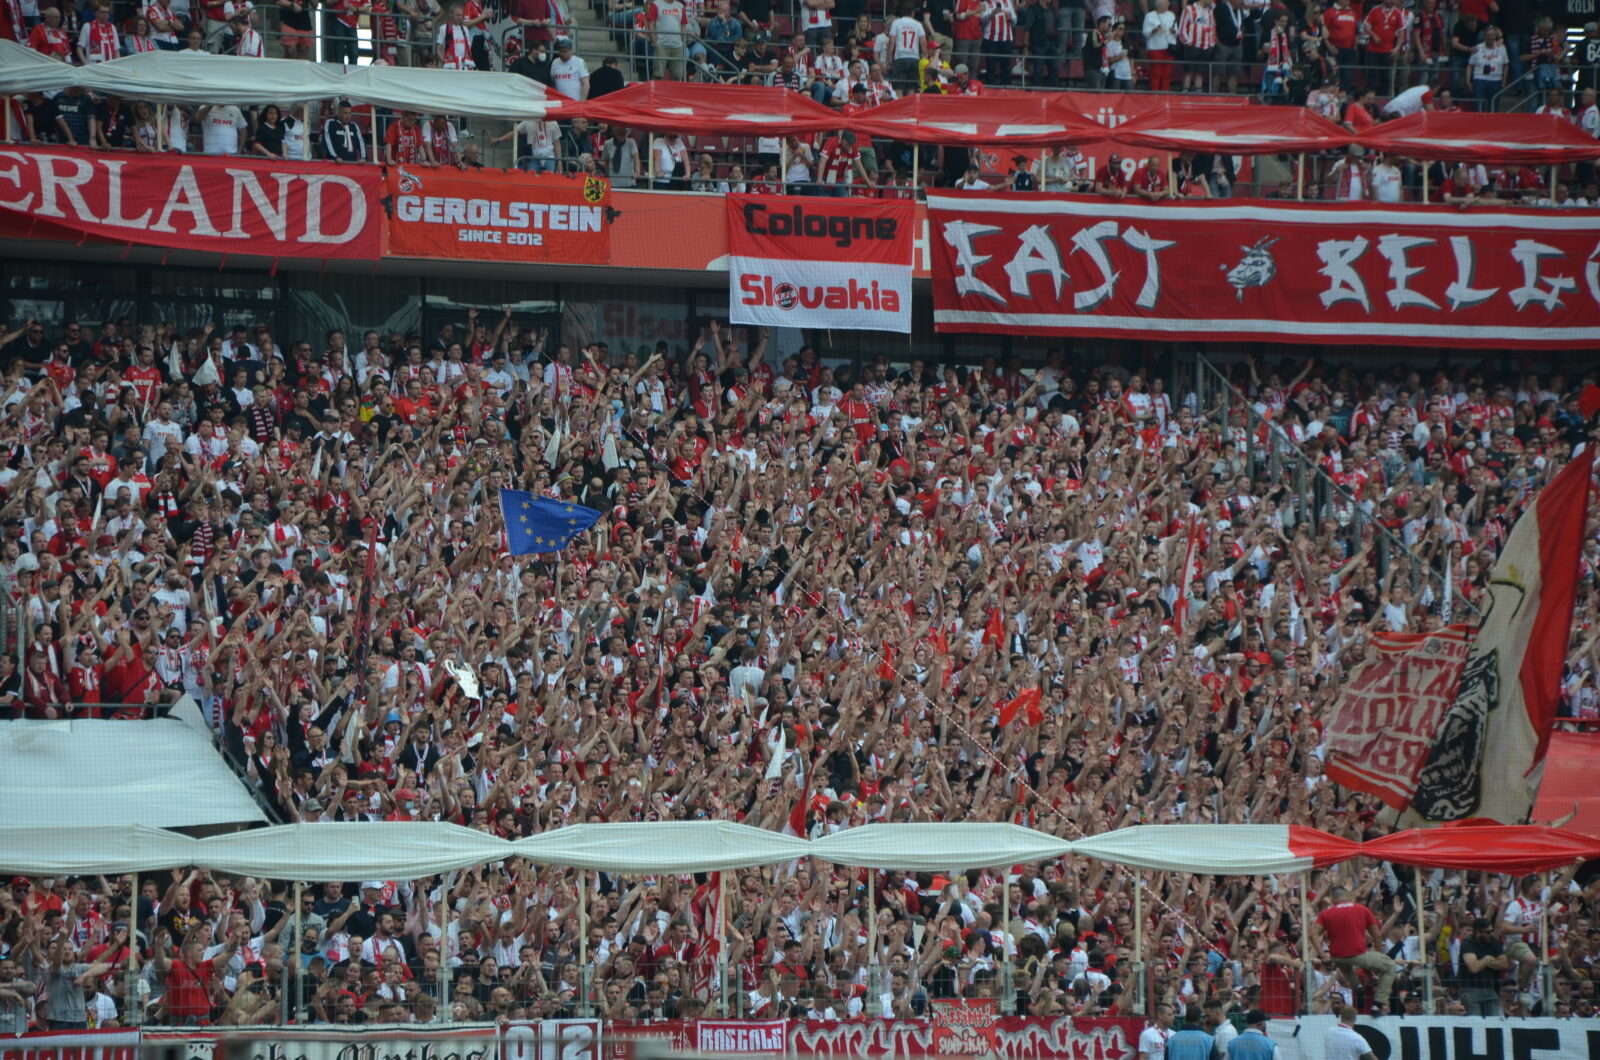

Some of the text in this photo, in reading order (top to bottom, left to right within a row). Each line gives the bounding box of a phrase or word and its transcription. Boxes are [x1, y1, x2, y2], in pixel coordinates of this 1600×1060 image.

[902, 30, 916, 48] 17
[212, 117, 233, 126] REWE
[397, 195, 602, 232] GEROLSTEIN
[743, 203, 897, 248] Cologne
[458, 229, 542, 246] SINCE 2012
[943, 219, 1600, 315] EAST BELG
[133, 379, 154, 387] REWE
[702, 1027, 783, 1051] RASCALS
